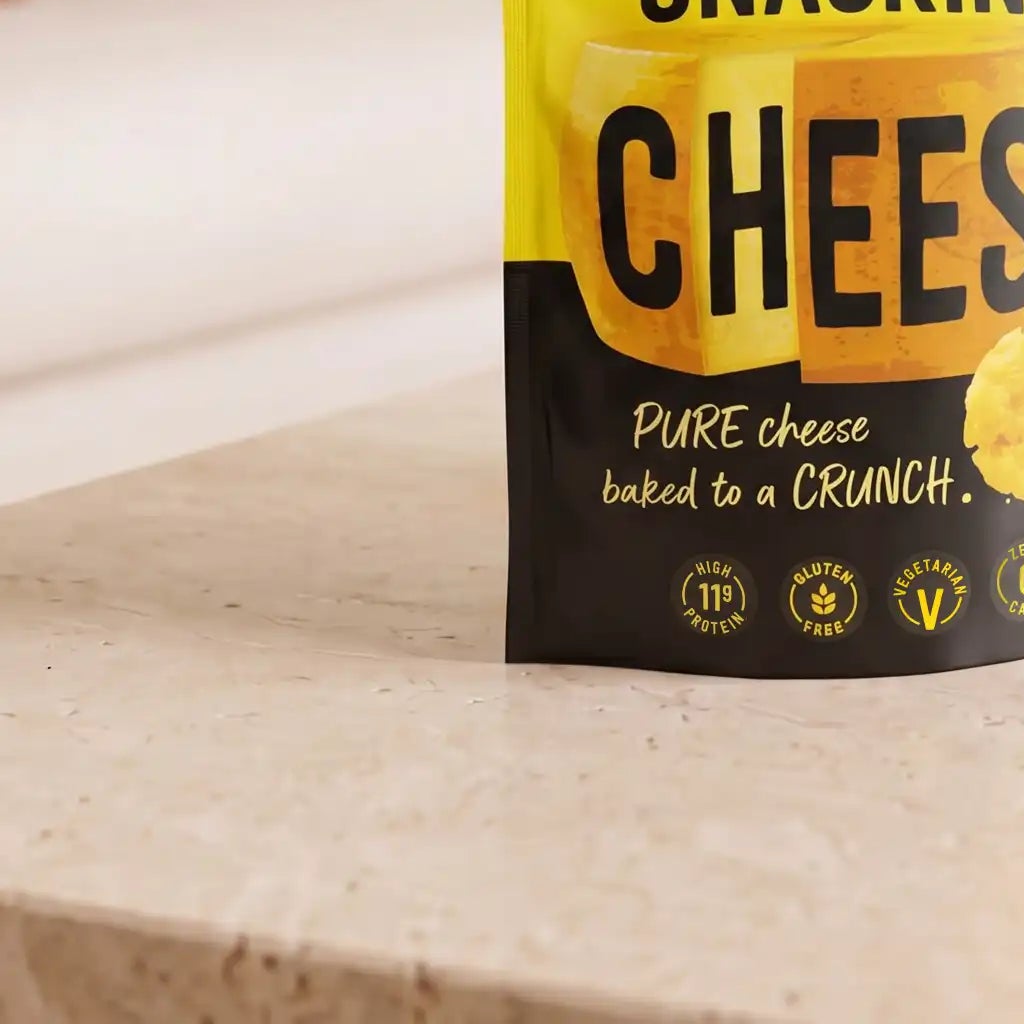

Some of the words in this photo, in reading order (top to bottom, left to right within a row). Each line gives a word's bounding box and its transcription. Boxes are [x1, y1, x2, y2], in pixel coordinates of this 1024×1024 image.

[633, 401, 748, 449] PURE
[758, 402, 870, 448] cheese
[602, 467, 698, 509] baked
[711, 471, 741, 508] to
[757, 487, 776, 508] a
[793, 456, 972, 511] CRUNCH.
[695, 561, 732, 578] HIGH
[793, 562, 854, 585] GLUTEN
[893, 559, 967, 597] VEGETARIAN
[699, 582, 733, 612] 11g
[916, 588, 944, 631] V
[683, 607, 745, 635] PROTEIN
[803, 619, 844, 637] FREE
